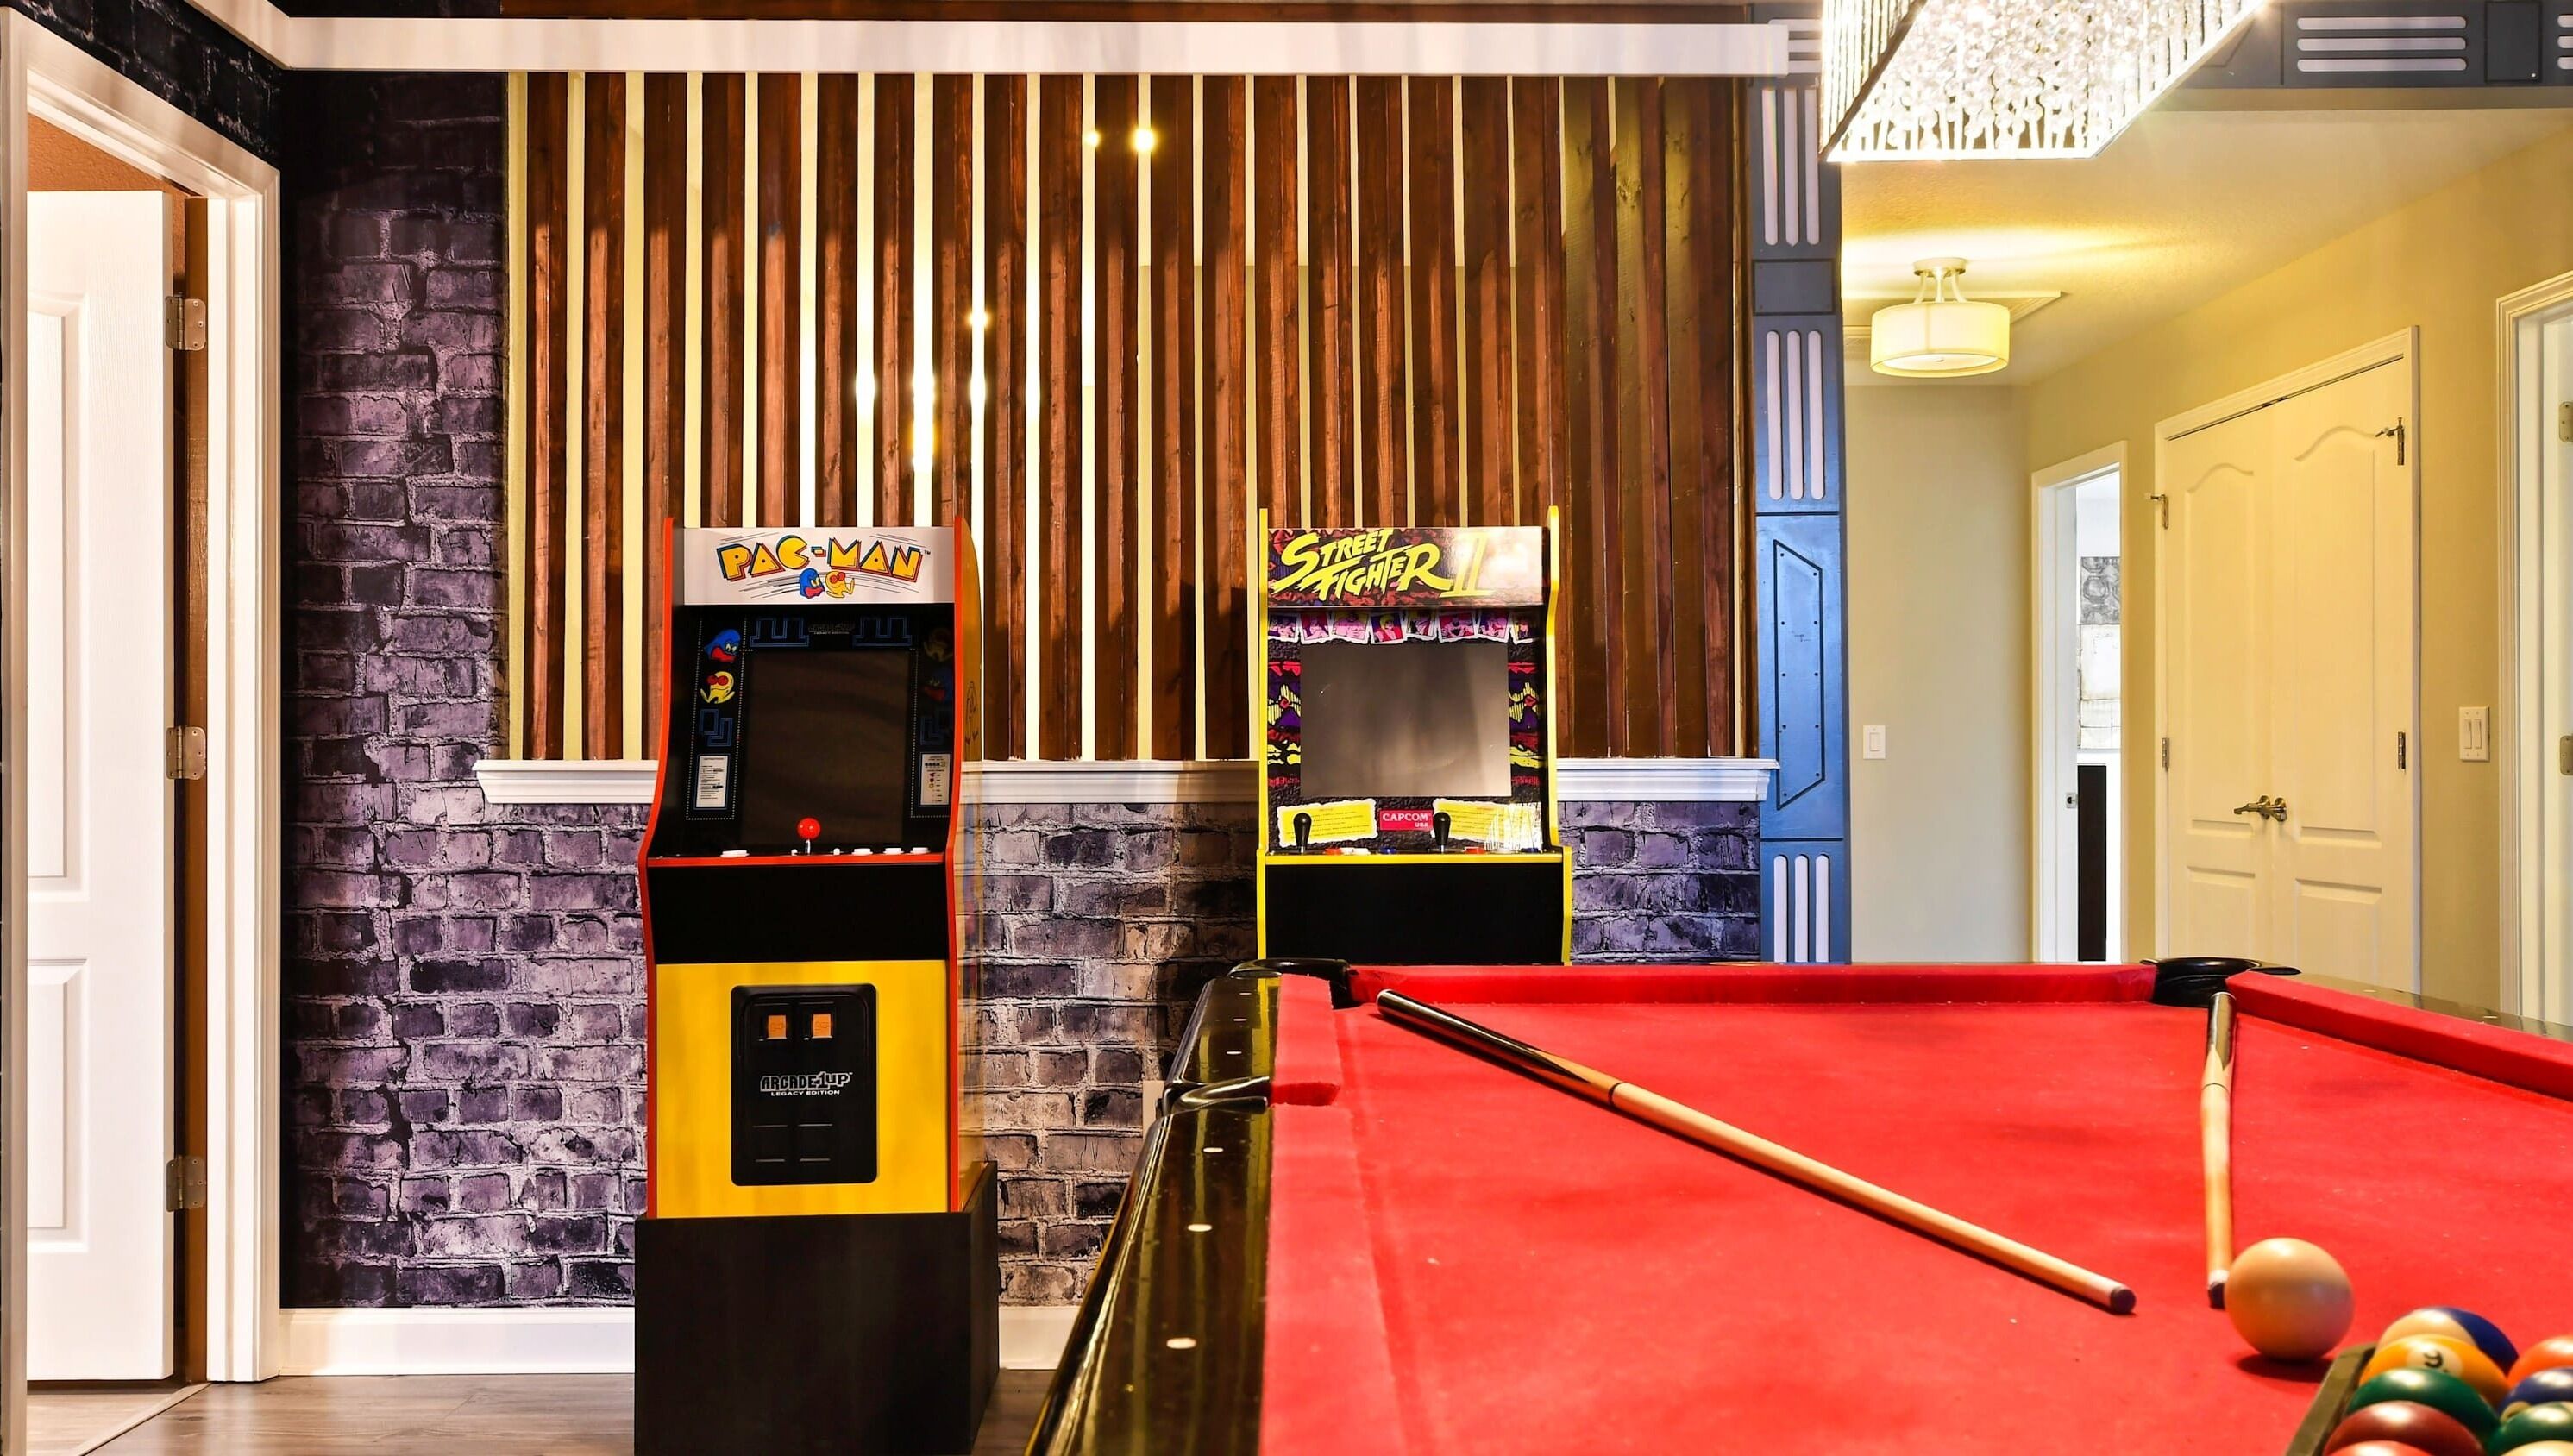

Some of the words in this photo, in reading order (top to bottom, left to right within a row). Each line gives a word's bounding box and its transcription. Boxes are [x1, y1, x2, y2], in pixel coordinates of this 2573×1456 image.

[717, 535, 923, 582] PAC-MAN
[1271, 530, 1394, 594] STREET
[1295, 543, 1454, 601] FIGHTER
[1440, 531, 1494, 598] II
[1382, 813, 1429, 822] CAPCOM
